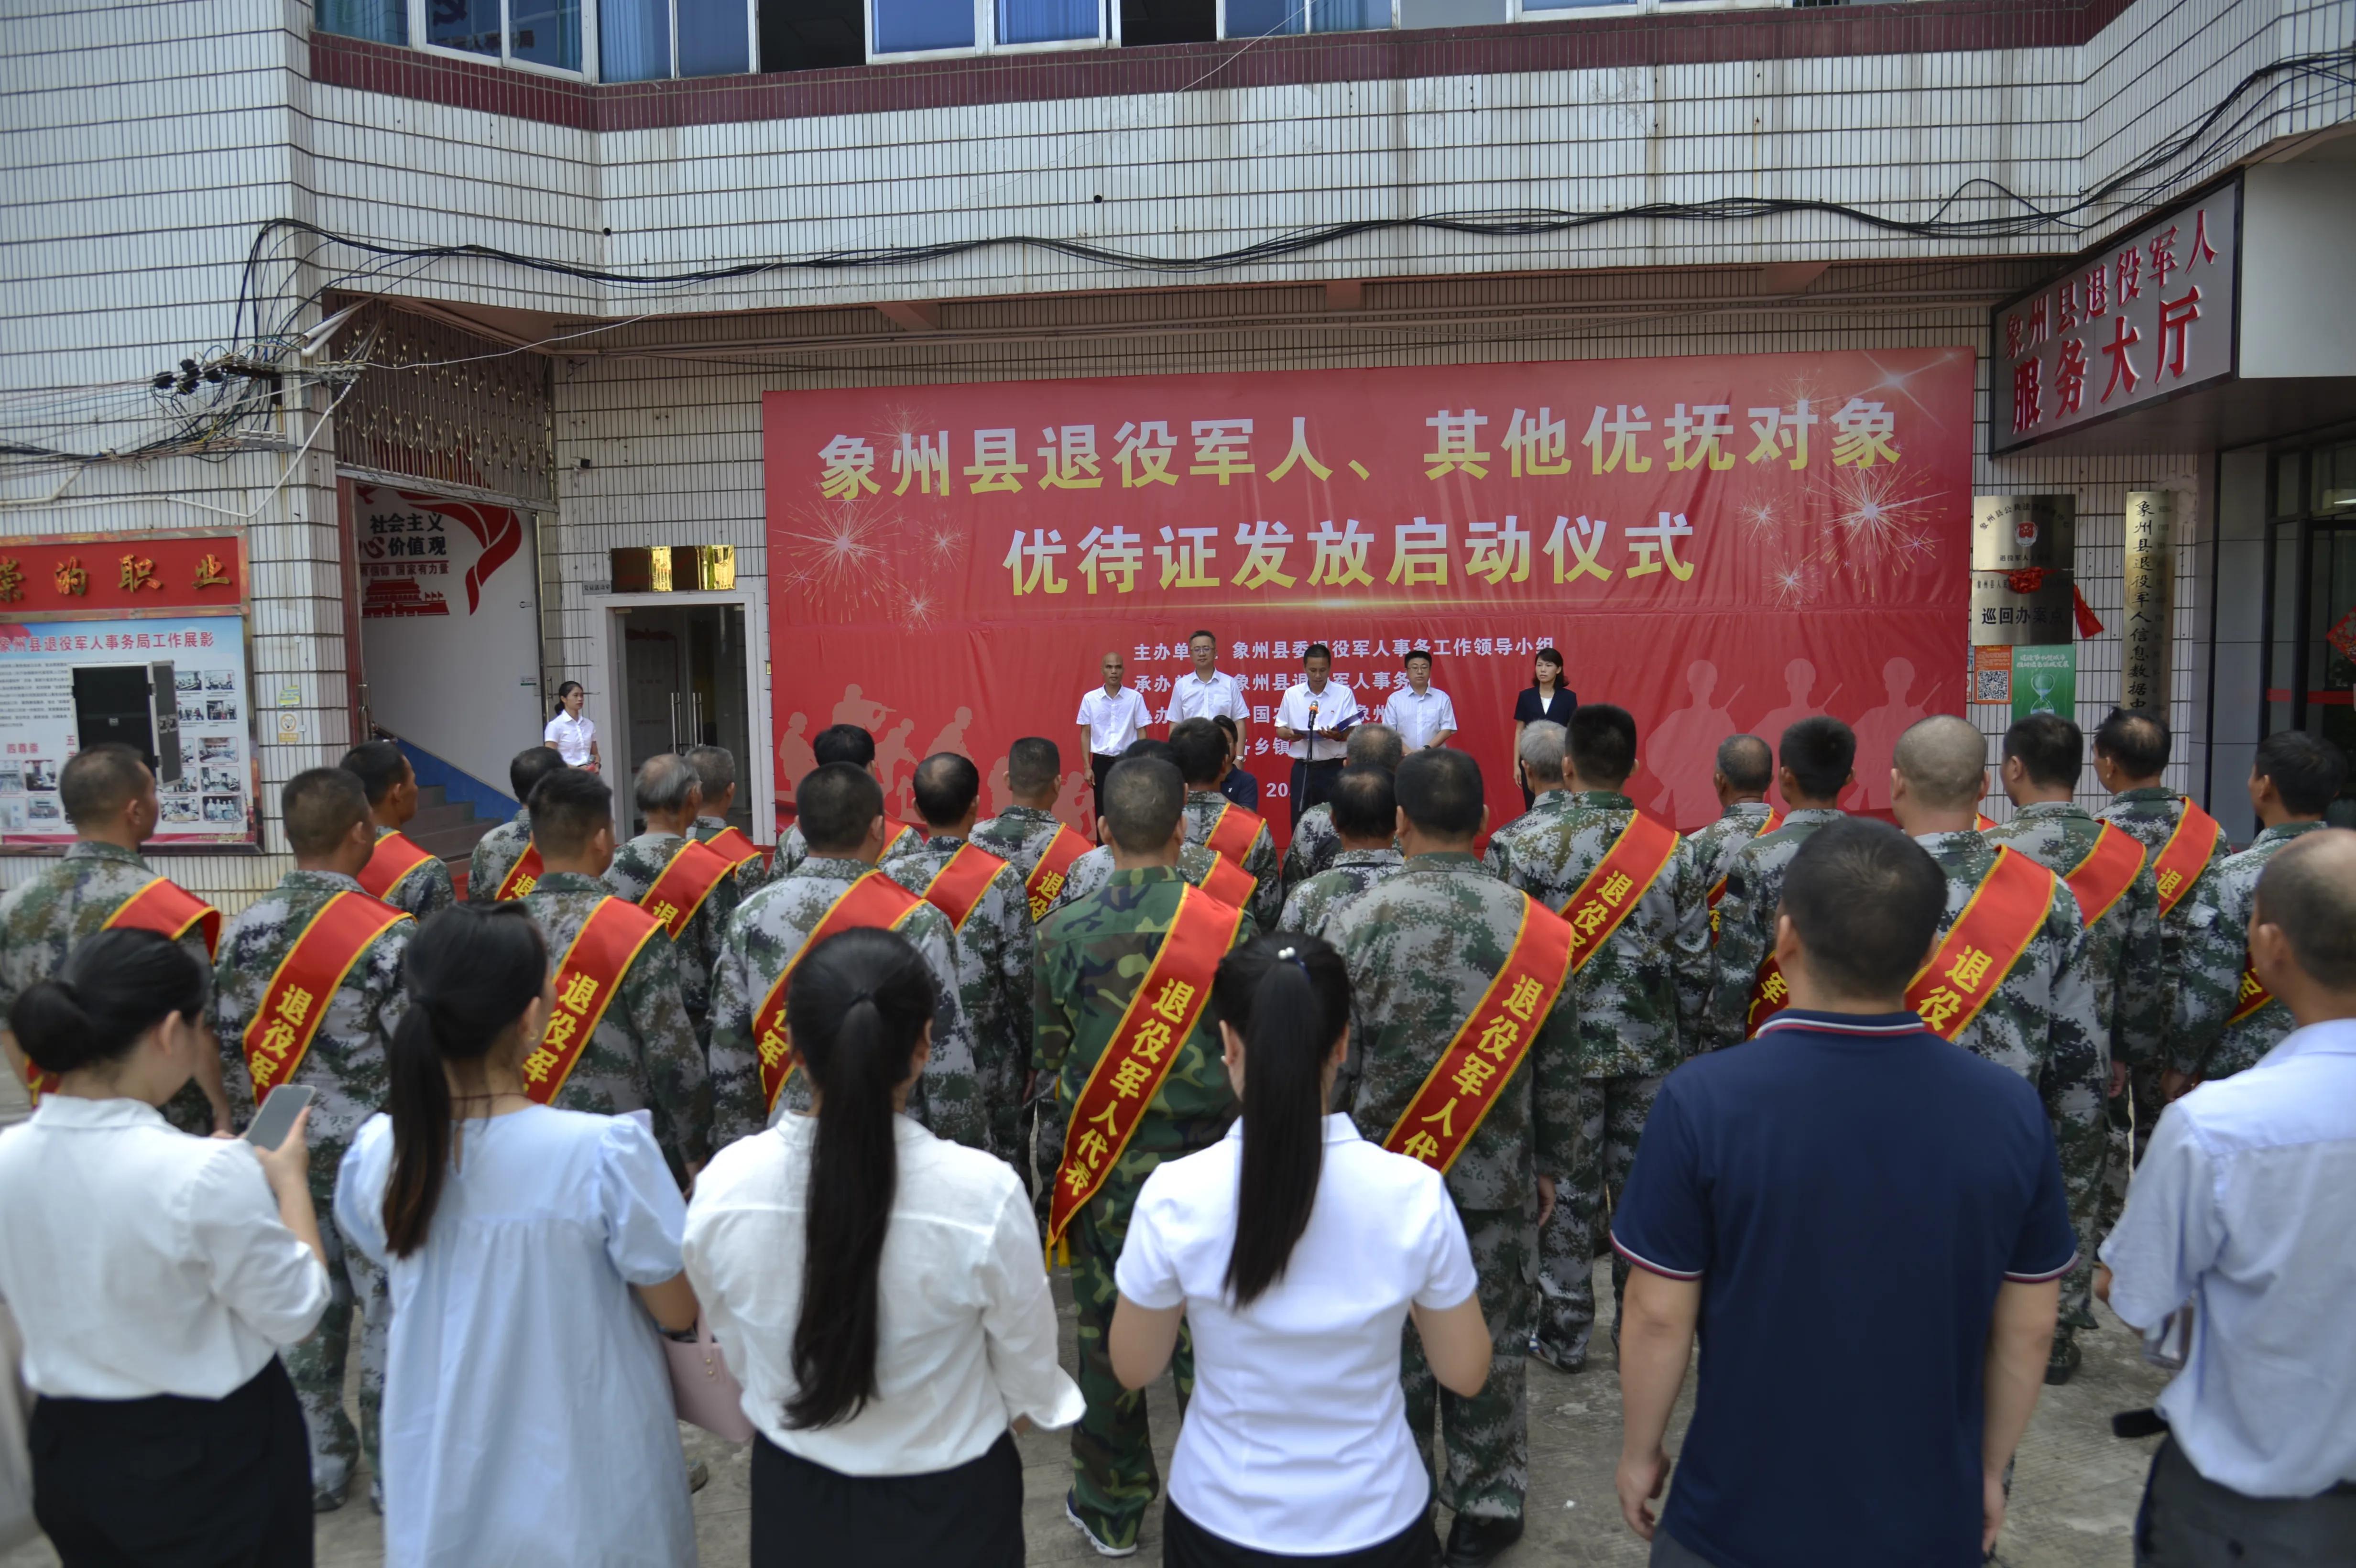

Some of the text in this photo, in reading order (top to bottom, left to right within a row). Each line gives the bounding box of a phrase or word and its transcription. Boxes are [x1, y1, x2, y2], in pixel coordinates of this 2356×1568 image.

[2005, 208, 2218, 359] 象州县退役军人
[2012, 284, 2200, 435] 服务大厅
[370, 512, 445, 534] 社会主义
[1002, 512, 1695, 596] 优待证发放启动仪式
[1982, 606, 2064, 625] 巡回办案点
[1065, 978, 1196, 1196] 退役军人代表
